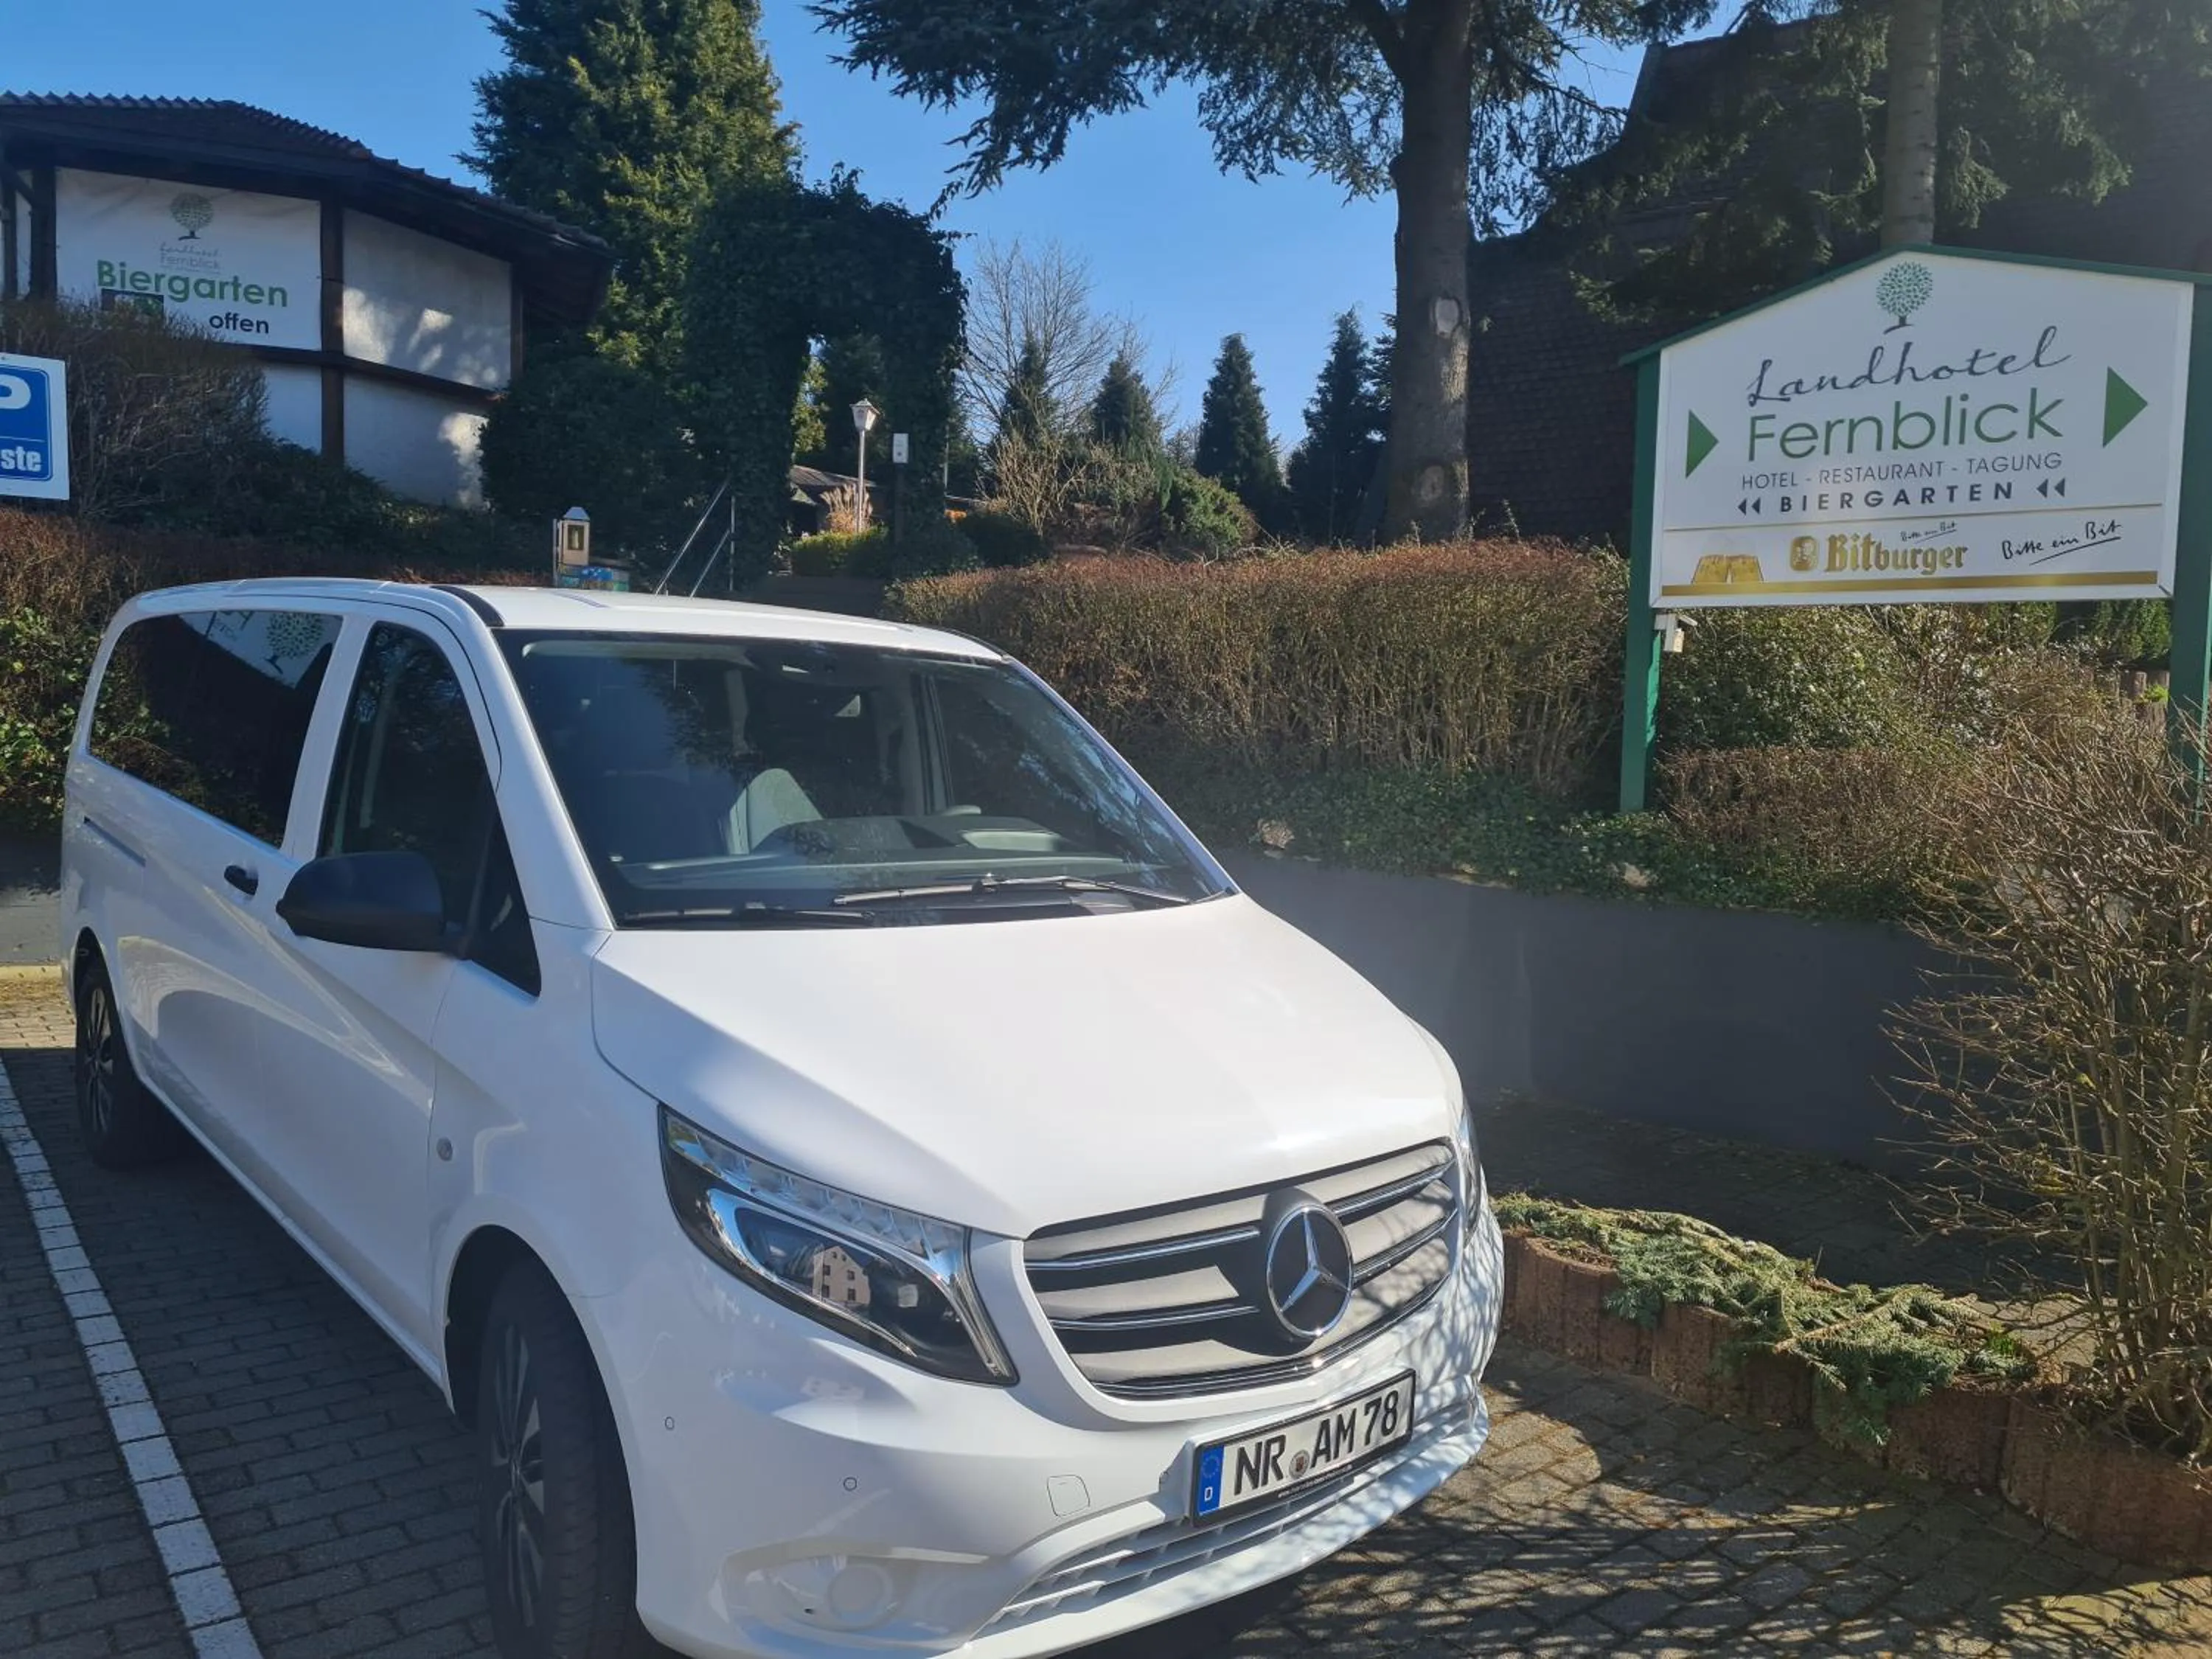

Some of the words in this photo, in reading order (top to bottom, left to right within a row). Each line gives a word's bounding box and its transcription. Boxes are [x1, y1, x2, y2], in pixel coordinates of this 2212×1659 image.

[97, 259, 288, 307] Biergarten
[209, 311, 269, 333] offen
[1747, 325, 2072, 407] Landhotel
[1747, 387, 2065, 462] Fernblick
[1742, 471, 1798, 490] HOTEL
[1818, 460, 1945, 485] RESTAURANT
[1966, 452, 2062, 474] TAGUNG
[1780, 481, 2013, 512] BIERGARTEN
[1824, 532, 1969, 575] Bitburger
[2001, 540, 2044, 560] Bitte
[2051, 536, 2079, 549] ein
[2085, 519, 2123, 540] Bit
[1234, 1434, 1287, 1496] NR
[1310, 1408, 1357, 1468] AM
[1364, 1390, 1399, 1446] 78
